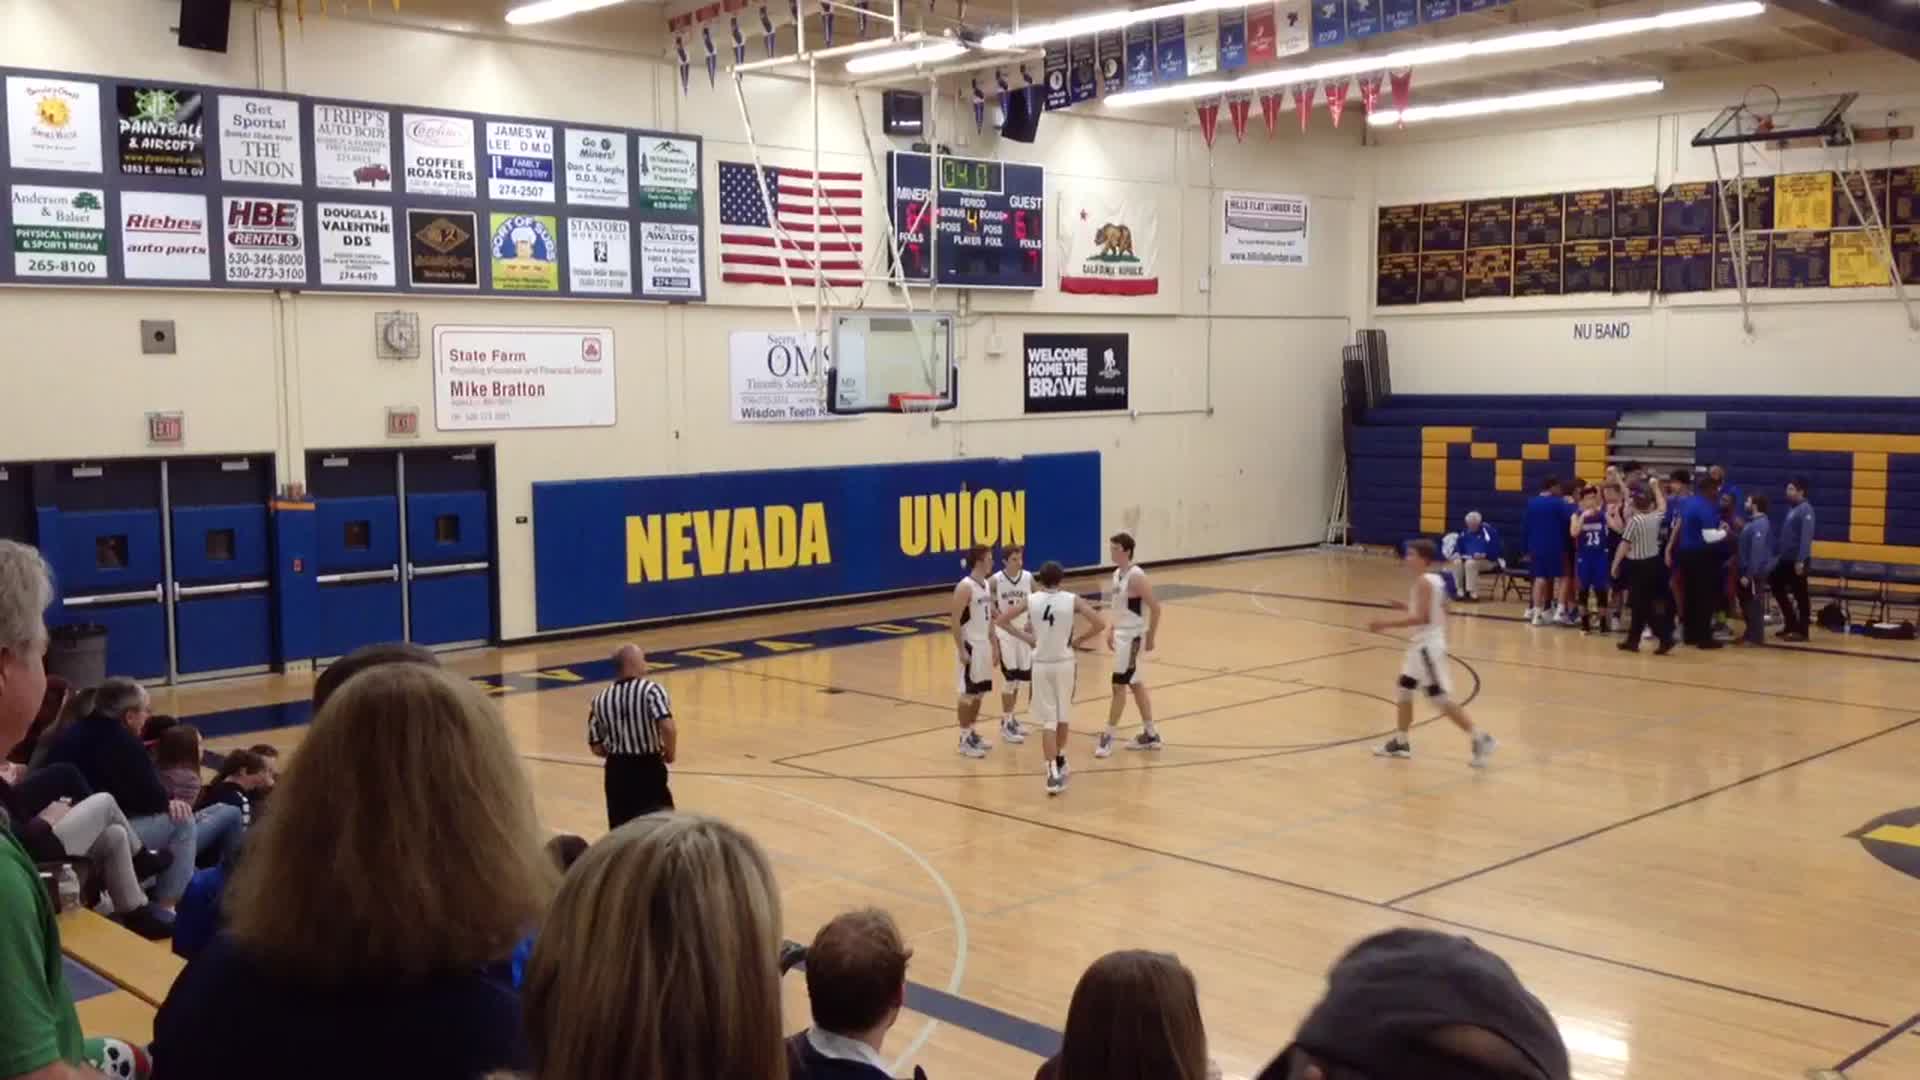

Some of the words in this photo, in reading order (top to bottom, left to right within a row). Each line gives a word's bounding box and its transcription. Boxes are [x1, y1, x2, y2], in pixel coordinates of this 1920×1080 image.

[246, 102, 272, 115] Get
[233, 114, 286, 129] Sports!
[319, 107, 385, 127] TRIPP'S
[119, 117, 203, 139] PAINTBALL
[318, 123, 352, 137] AUTO
[354, 126, 385, 139] BODY
[495, 125, 533, 139] JAMES
[128, 137, 138, 149] &
[141, 138, 195, 152] AIRSOFT
[582, 137, 597, 147] Go
[241, 141, 280, 159] THE
[579, 148, 616, 160] Miners!
[228, 159, 295, 179] UNION
[416, 157, 464, 169] COFFEE
[512, 158, 541, 169] FAMILY
[407, 167, 474, 181] ROASTERS
[504, 167, 549, 179] DENTISTRY
[499, 184, 544, 197] 274-2507
[896, 186, 934, 202] MINER
[1009, 194, 1042, 209] GUEST
[14, 191, 69, 206] Anderson
[960, 197, 987, 208] PERIOD
[41, 206, 51, 217] &
[228, 200, 298, 229] HBE
[323, 207, 378, 220] DOUGLAS
[126, 213, 202, 231] Riebes
[321, 220, 391, 234] VALENTINE
[570, 220, 627, 233] STANFORD
[966, 209, 978, 233] 4
[16, 228, 62, 240] PHYSICAL
[63, 231, 103, 242] THERAPY
[646, 231, 695, 242] AWARDS
[983, 224, 1003, 235] POSS
[31, 240, 67, 250] SPORTS
[68, 242, 99, 252] REHAB
[234, 233, 294, 247] RENTALS
[343, 235, 371, 247] DDS
[953, 233, 981, 246] PLAYER
[984, 236, 1003, 247] FOUL
[1020, 238, 1042, 250] FOULS
[127, 243, 163, 254] auto
[165, 245, 207, 257] parts
[228, 252, 304, 266] 530-346-8000
[28, 259, 96, 274] 265-8100
[228, 266, 304, 280] 530-273-3100
[1574, 322, 1592, 340] NU
[1595, 322, 1631, 340] BAND
[449, 348, 487, 362] State
[491, 349, 526, 362] Farm
[1027, 347, 1088, 363] WELCOME
[1027, 362, 1063, 377] HOME
[1064, 361, 1088, 376] THE
[450, 380, 487, 398] Mike
[492, 381, 545, 398] Bratton
[1029, 376, 1087, 397] BRAVE
[740, 407, 786, 419] Wisdom
[789, 406, 816, 418] Teeth
[625, 501, 832, 585] NEVADA
[899, 487, 1026, 557] UNION
[1042, 604, 1055, 627] 4
